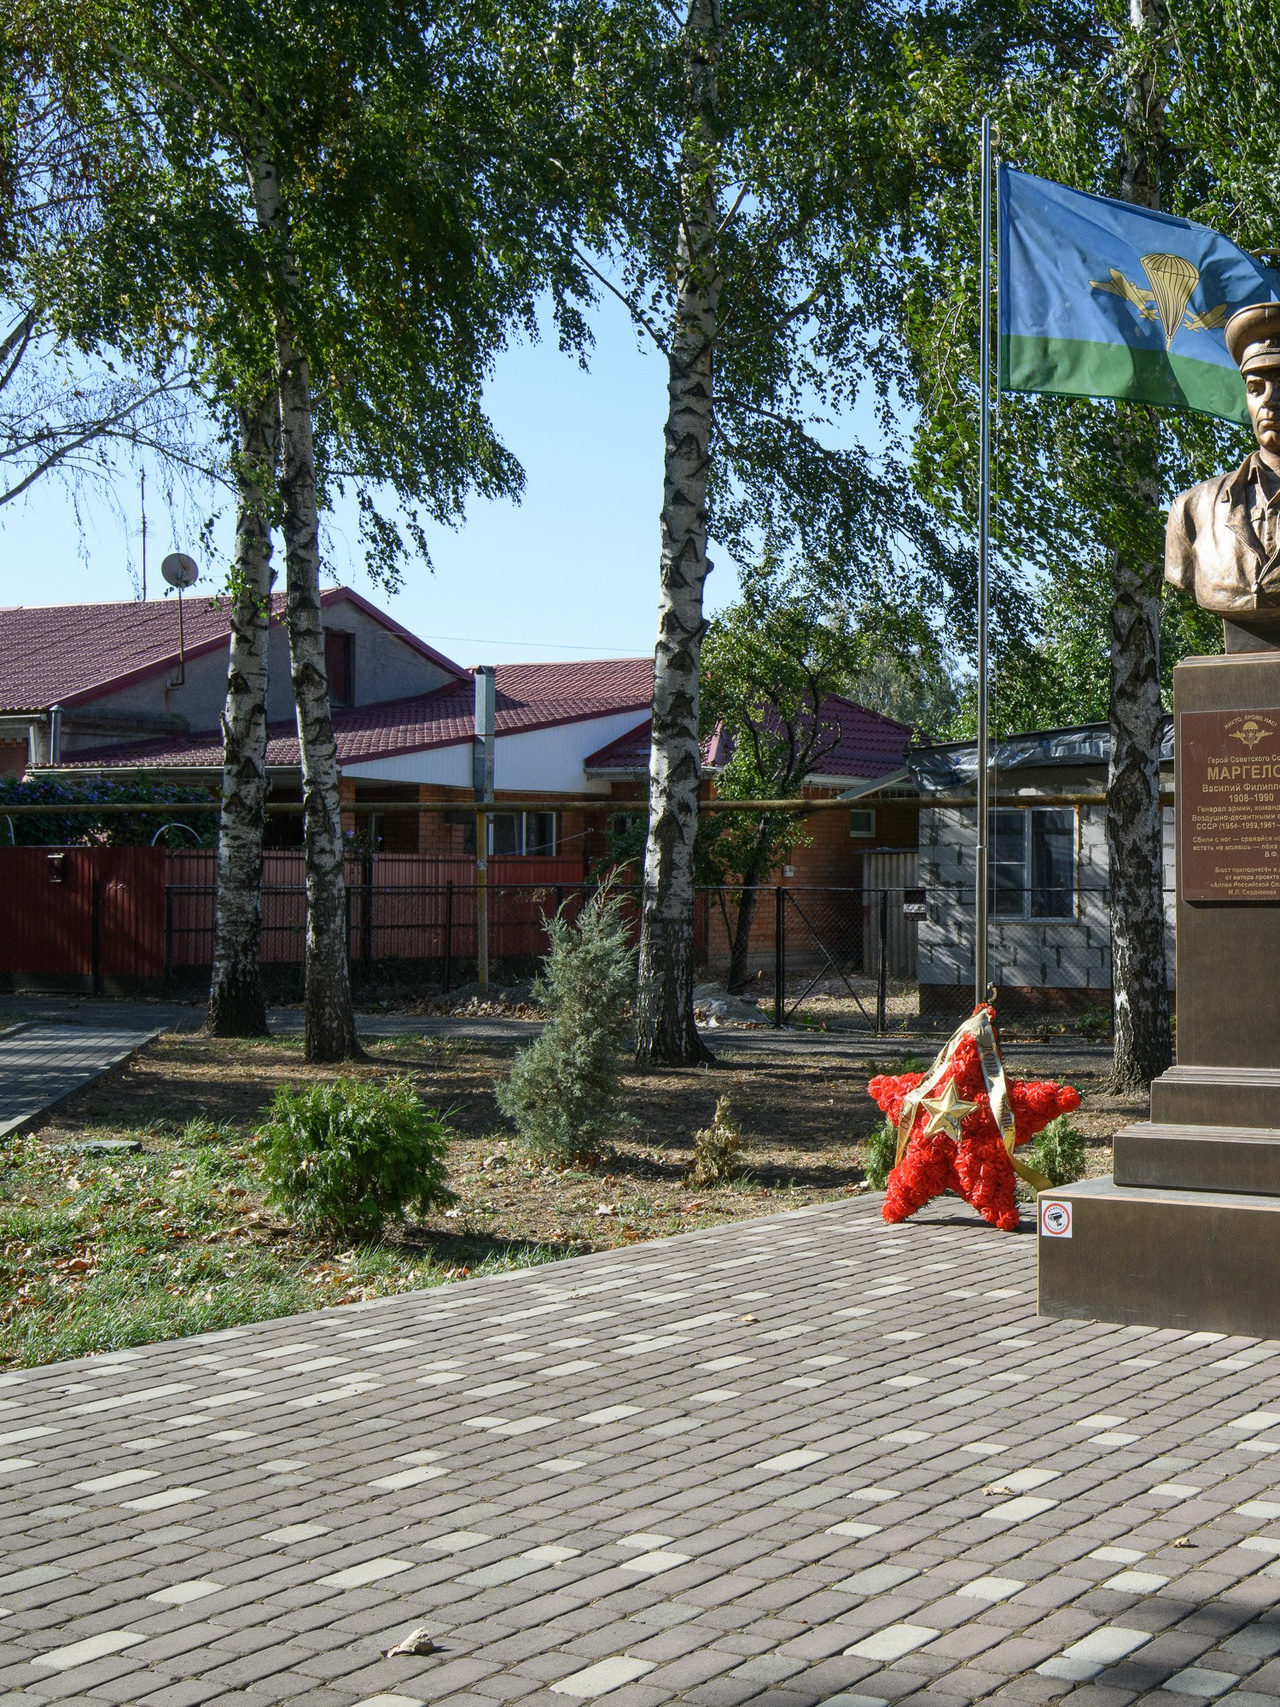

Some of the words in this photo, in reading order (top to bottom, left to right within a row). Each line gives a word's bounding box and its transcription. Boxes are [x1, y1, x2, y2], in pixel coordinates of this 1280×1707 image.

[1207, 756, 1229, 764] Герой
[1230, 755, 1270, 763] Советского
[1202, 783, 1241, 792] Василий
[1197, 805, 1226, 813] Генерал
[1228, 805, 1253, 813] армии,
[1191, 814, 1276, 822] Воздушно-десантными
[1196, 822, 1218, 830] СССР
[1240, 835, 1273, 843] сражайся
